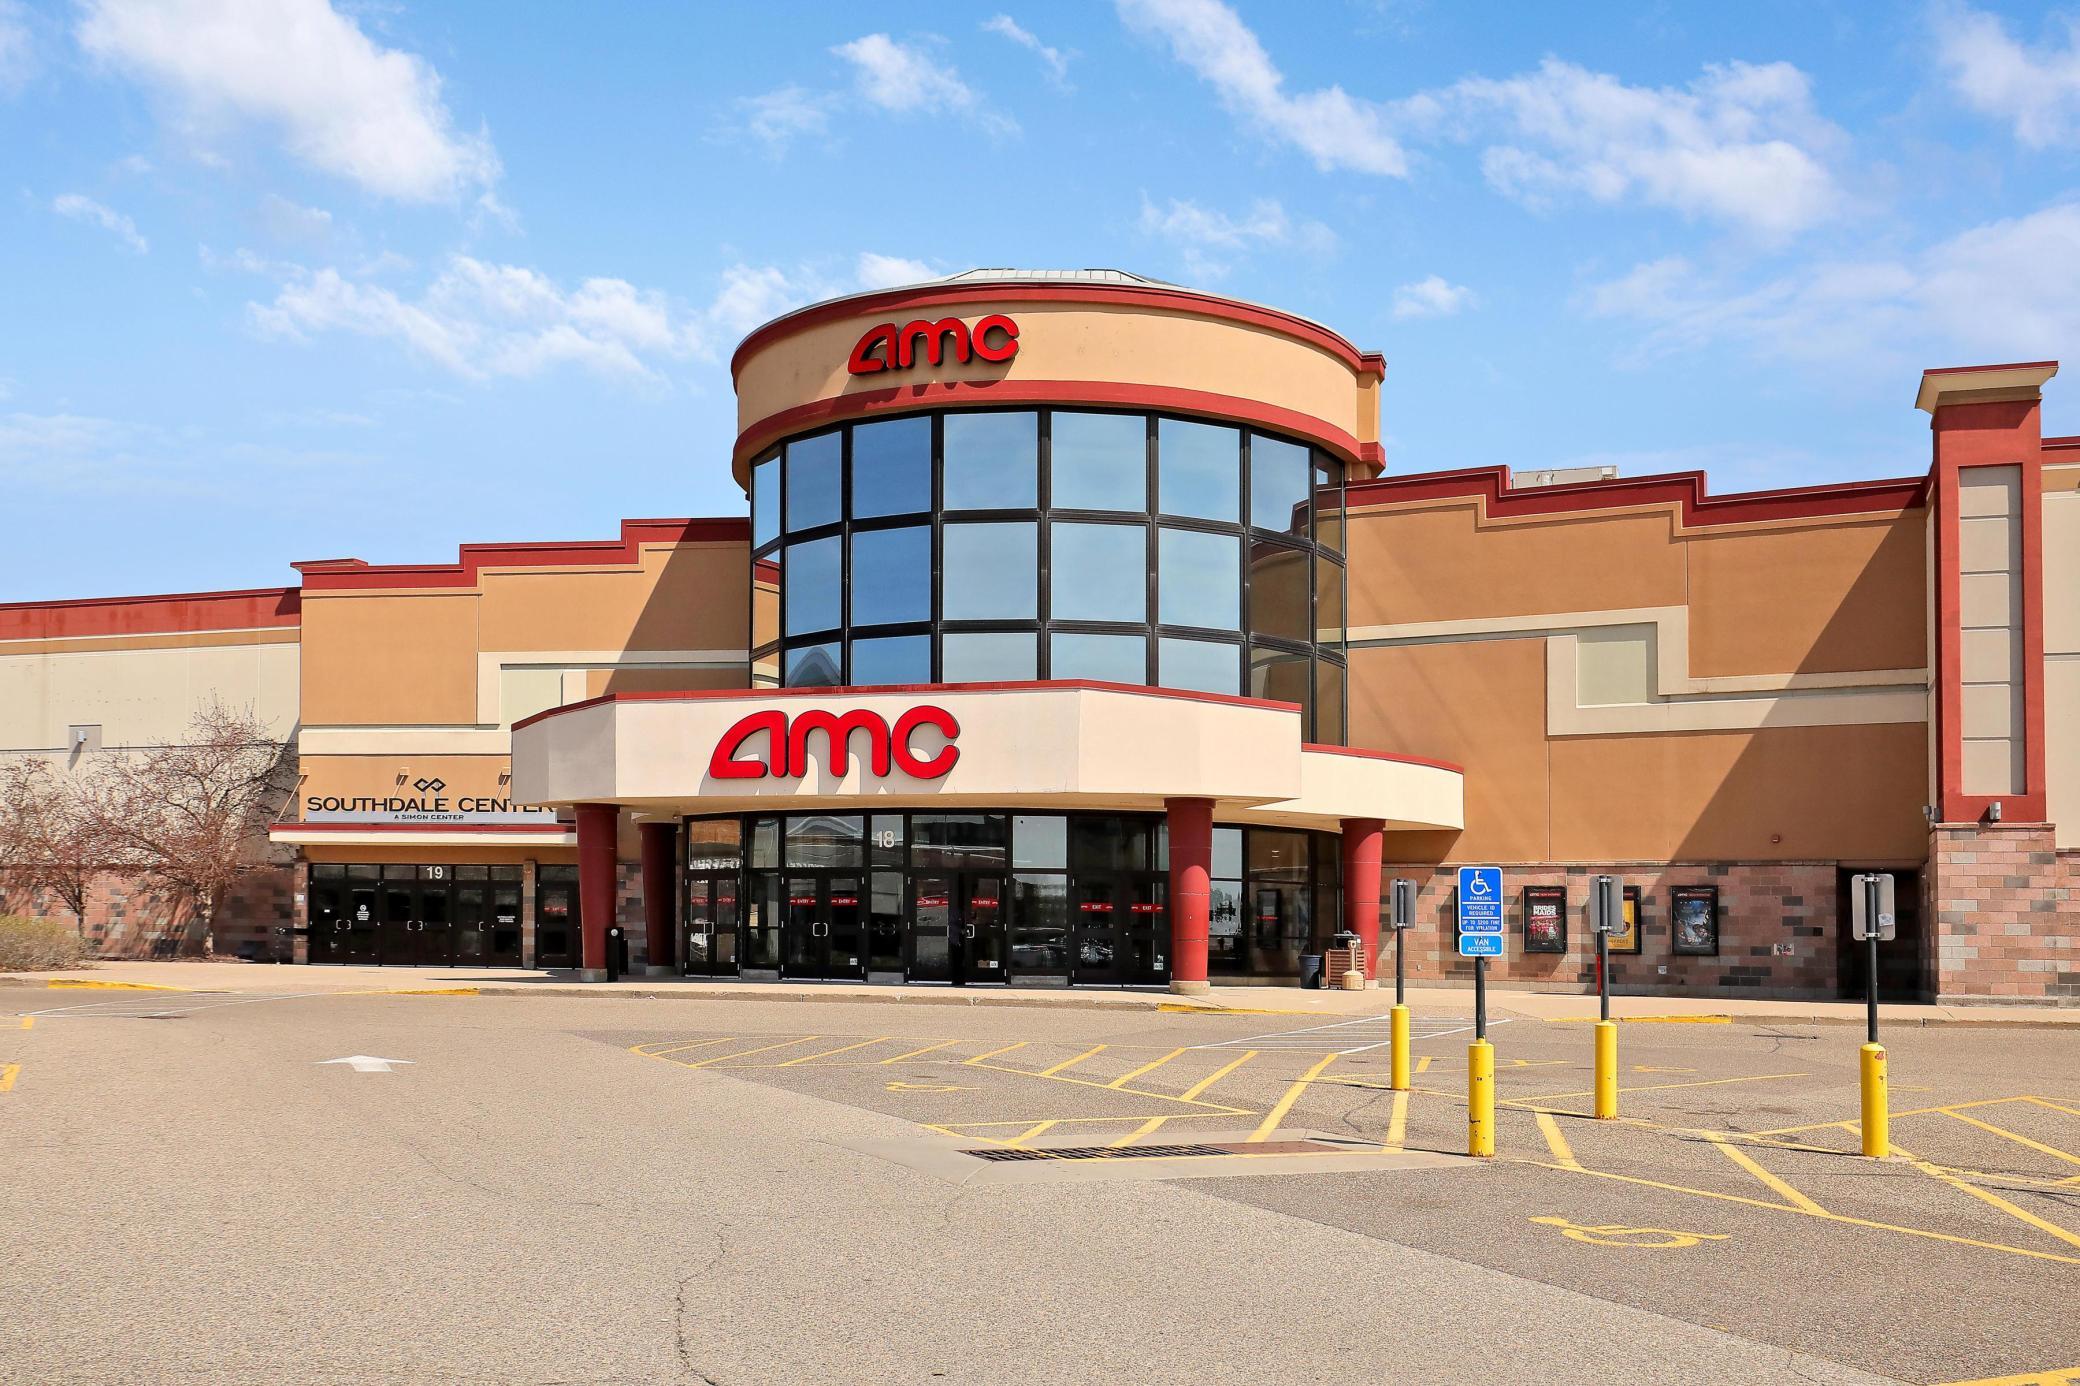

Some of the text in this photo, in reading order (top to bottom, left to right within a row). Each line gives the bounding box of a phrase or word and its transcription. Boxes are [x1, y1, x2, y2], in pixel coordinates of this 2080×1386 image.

[307, 797, 449, 812] SOUTHDALE
[878, 830, 895, 848] 18
[426, 865, 443, 879] 19
